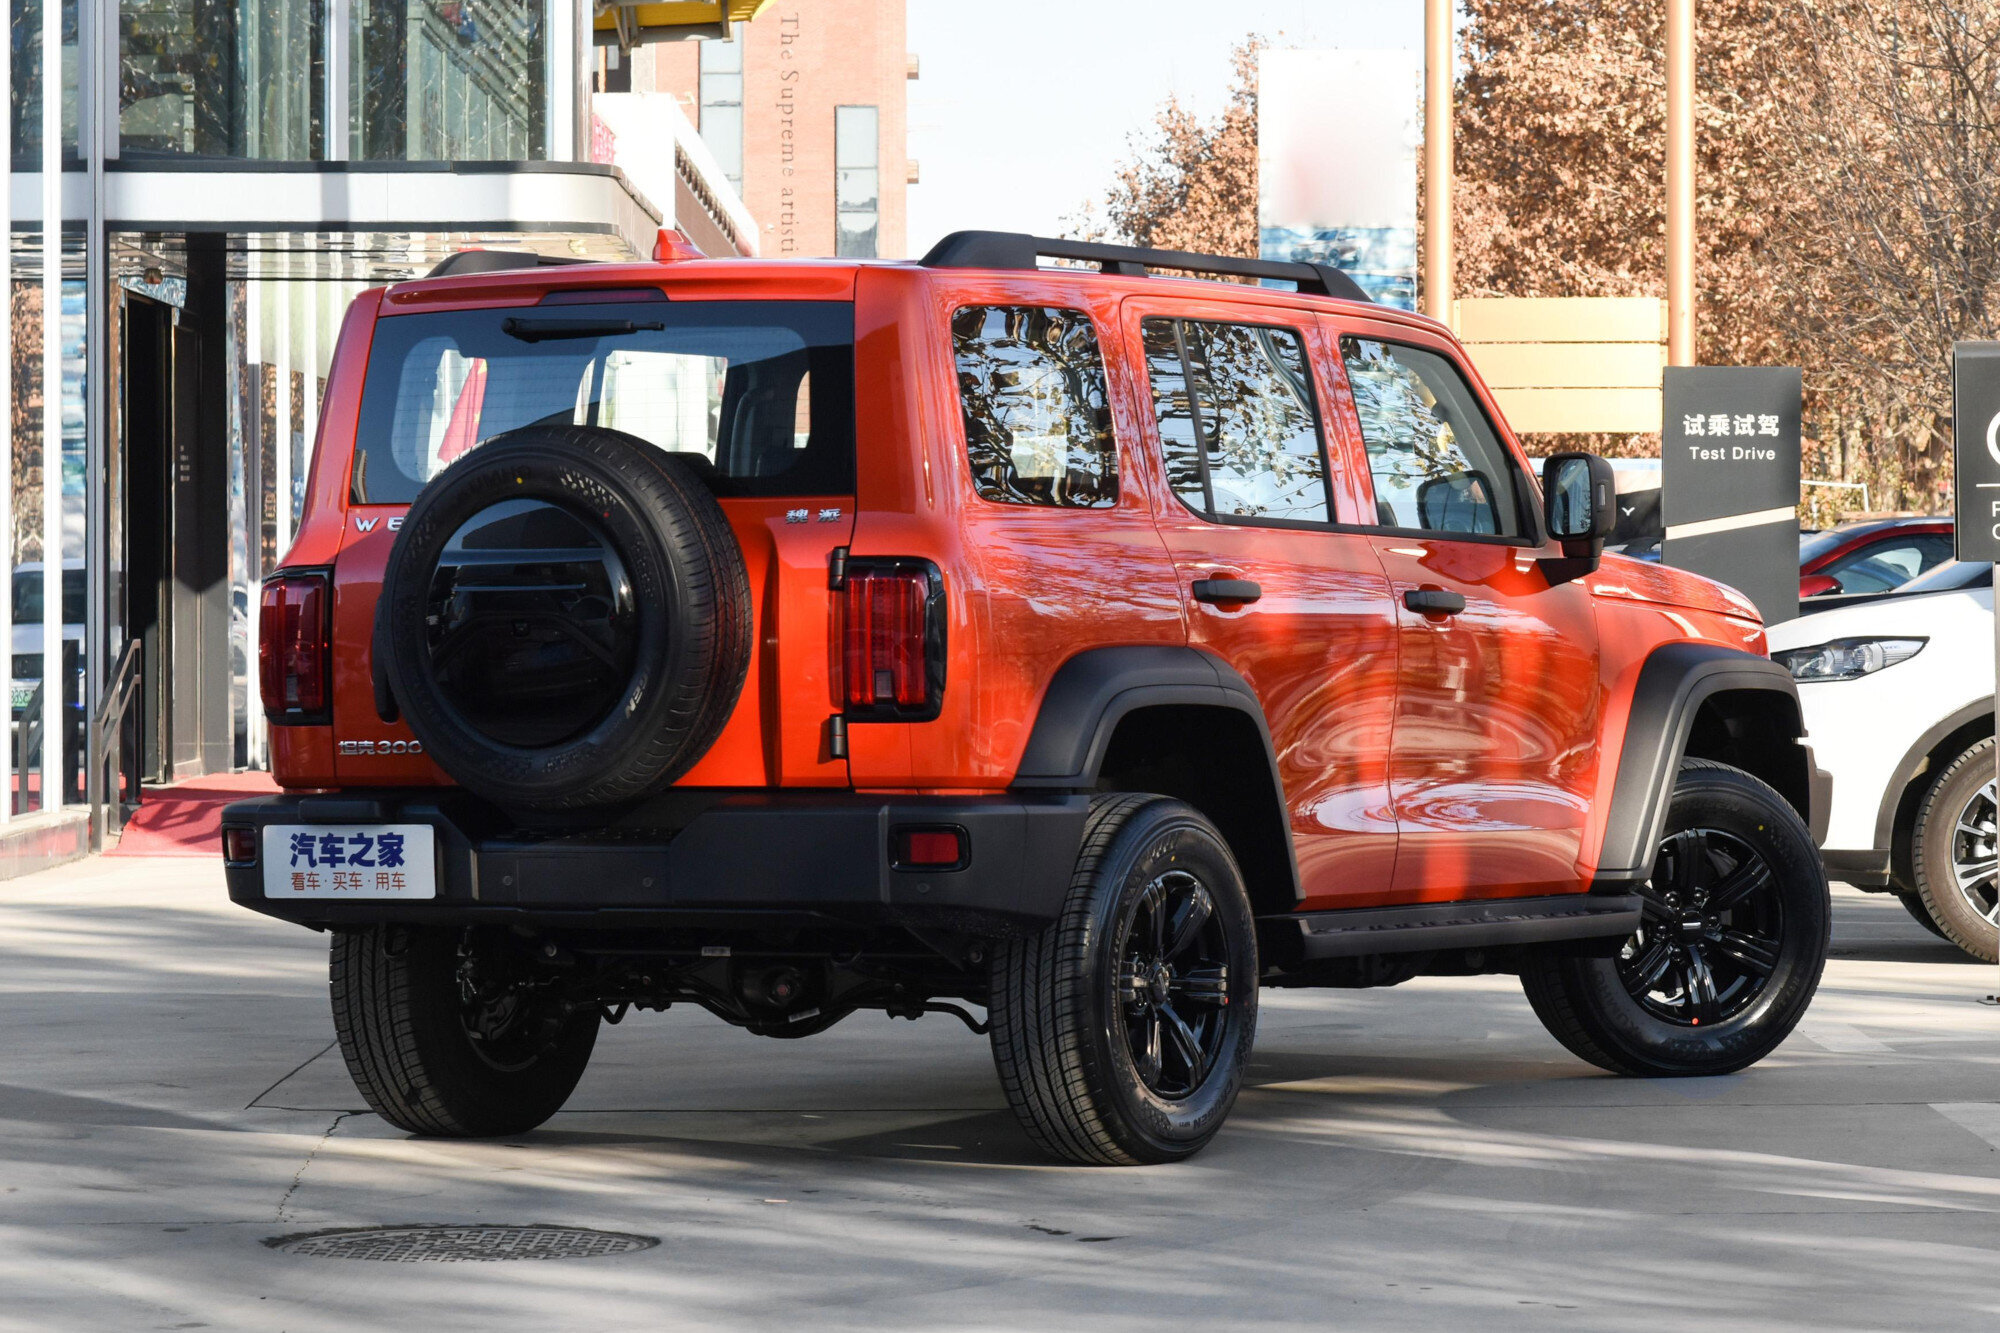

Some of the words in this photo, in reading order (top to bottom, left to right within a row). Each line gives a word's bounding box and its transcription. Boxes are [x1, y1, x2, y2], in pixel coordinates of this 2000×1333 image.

[781, 12, 799, 59] The
[776, 70, 799, 177] Supreme
[1683, 413, 1780, 437] 试乘试驾
[1689, 446, 1725, 461] Test
[1732, 446, 1776, 461] Drive
[290, 832, 406, 868] 汽车之家
